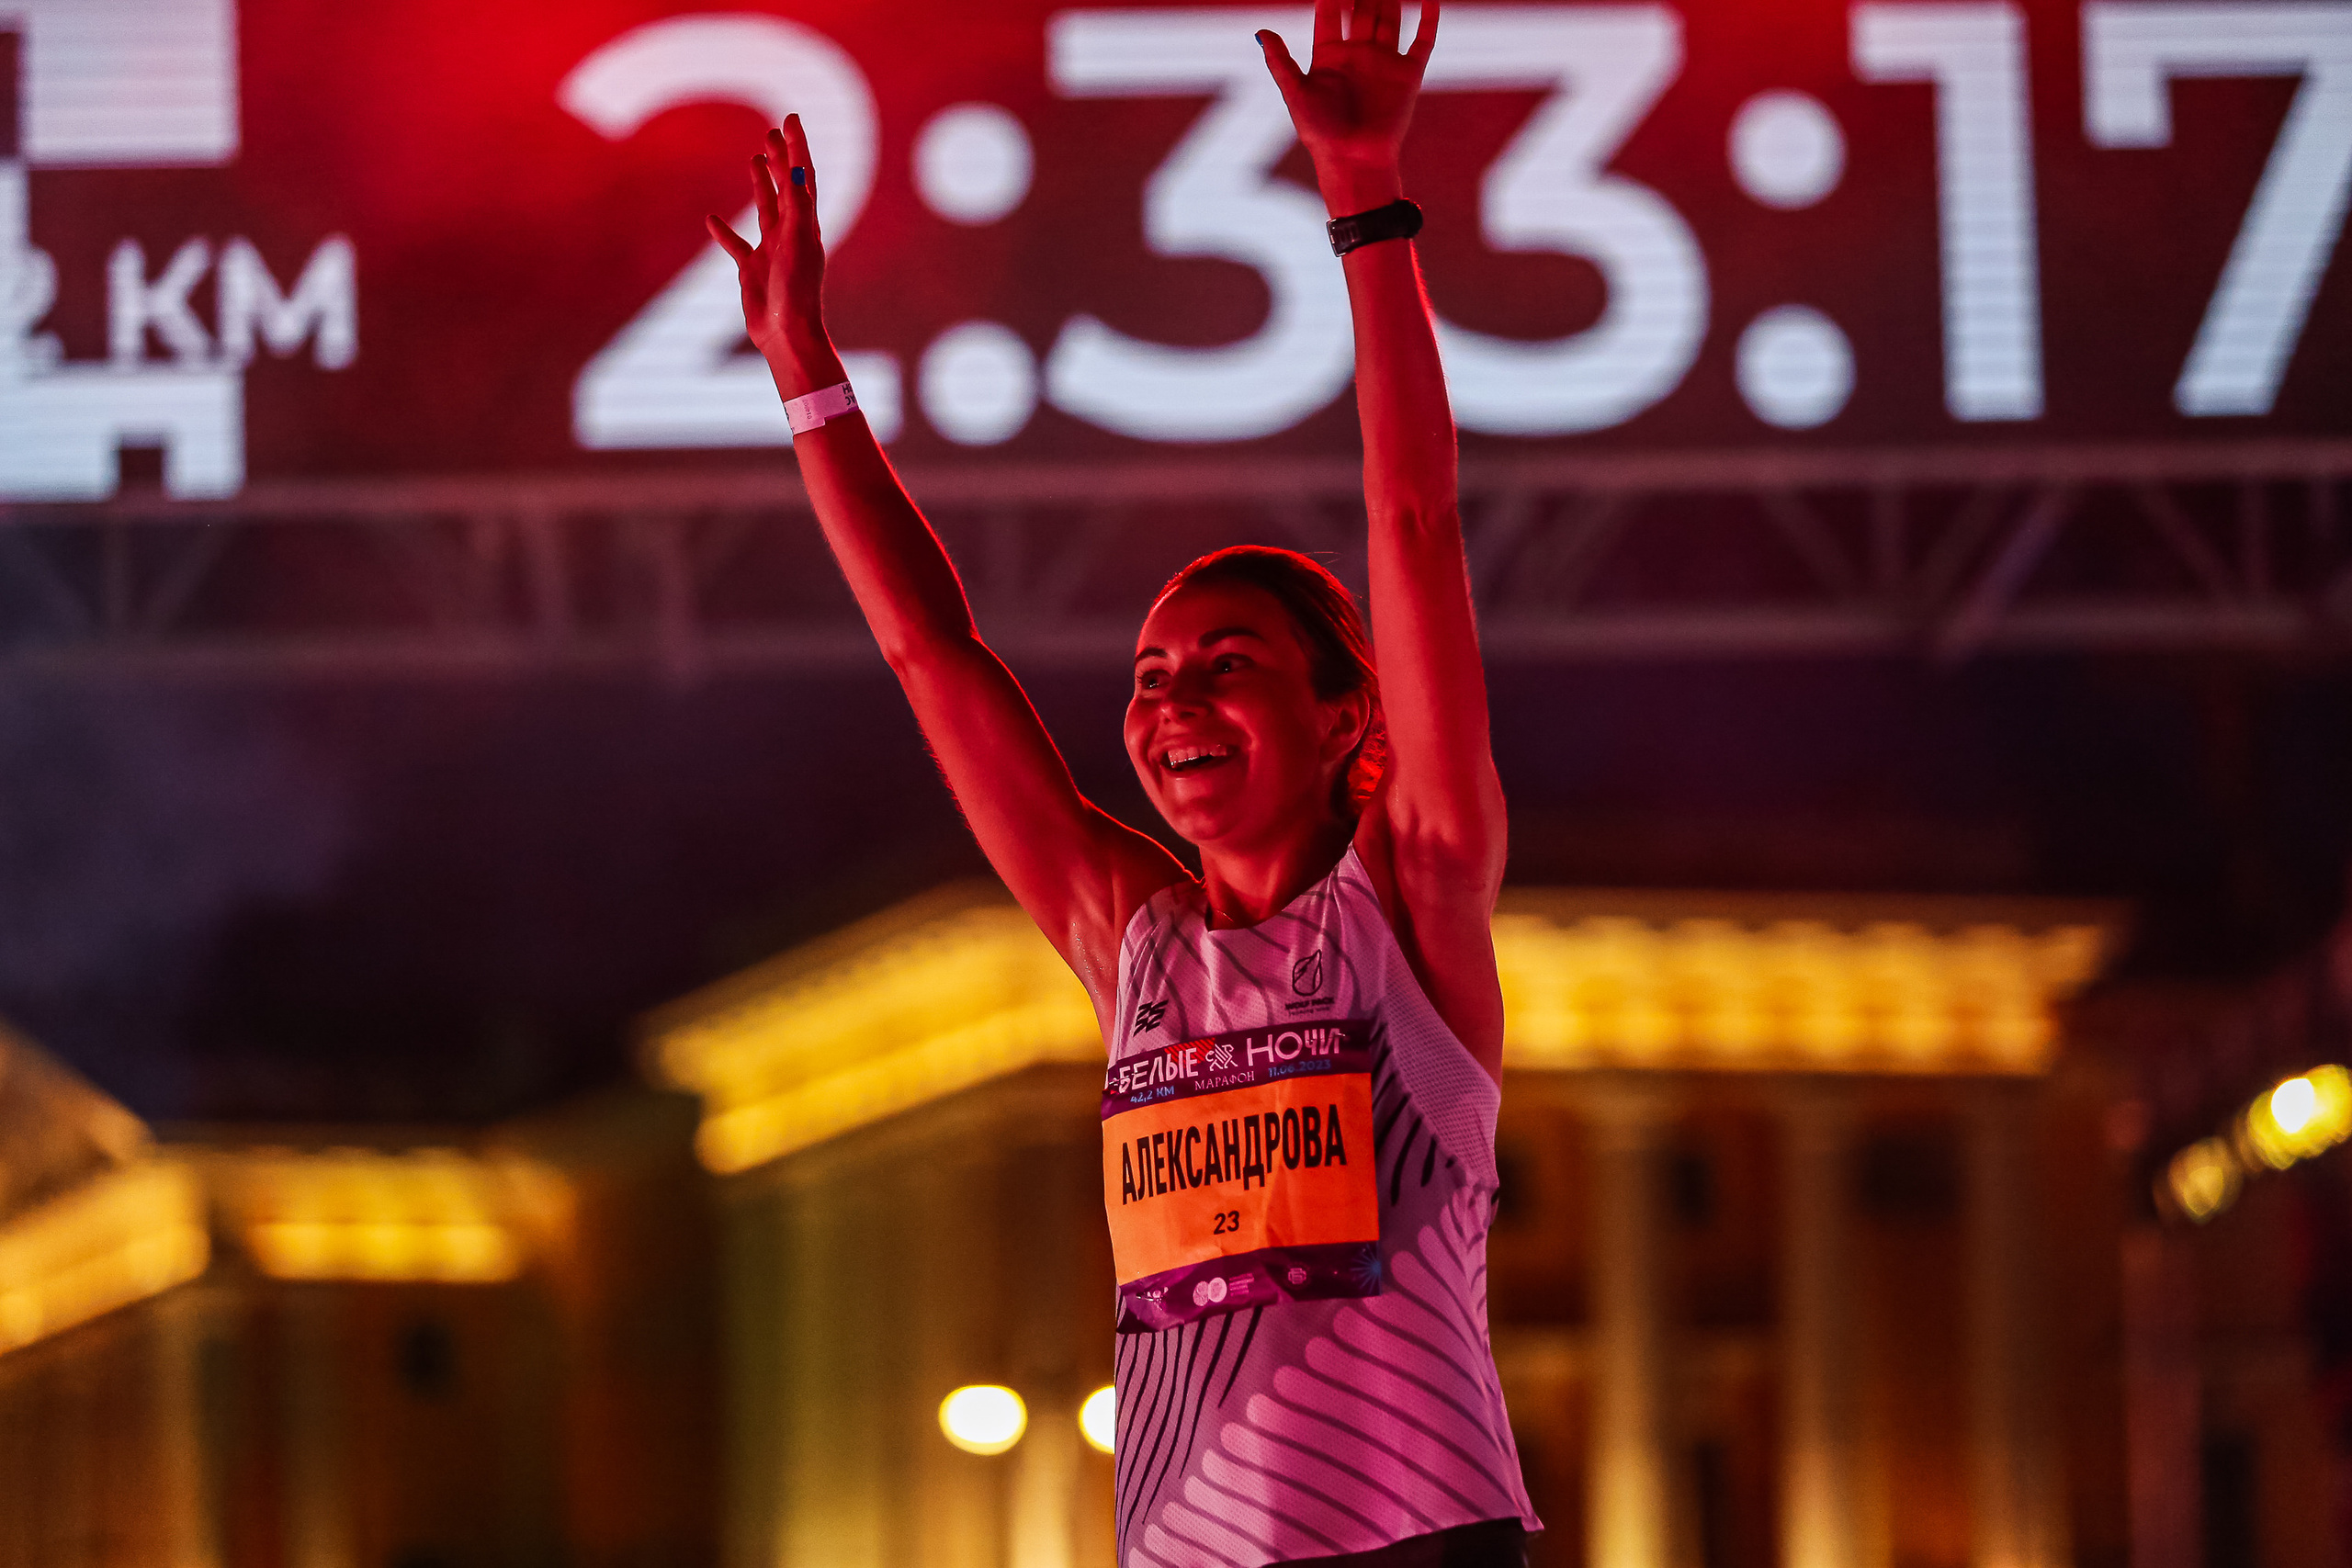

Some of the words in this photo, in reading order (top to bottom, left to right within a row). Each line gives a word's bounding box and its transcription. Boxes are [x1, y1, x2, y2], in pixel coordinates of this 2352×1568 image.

[556, 0, 2352, 448] 2:33:17
[1119, 1047, 1199, 1093] БЕЛЫЕ
[1246, 1028, 1340, 1066] НОЧИ
[1269, 1059, 1331, 1077] 11.06.2023
[1195, 1070, 1255, 1091] МАРАФОН
[1130, 1089, 1154, 1104] 42,2
[1156, 1085, 1175, 1098] КМ
[1122, 1103, 1348, 1206] АЛЕКСАНДРОВА
[1213, 1210, 1240, 1235] 23
